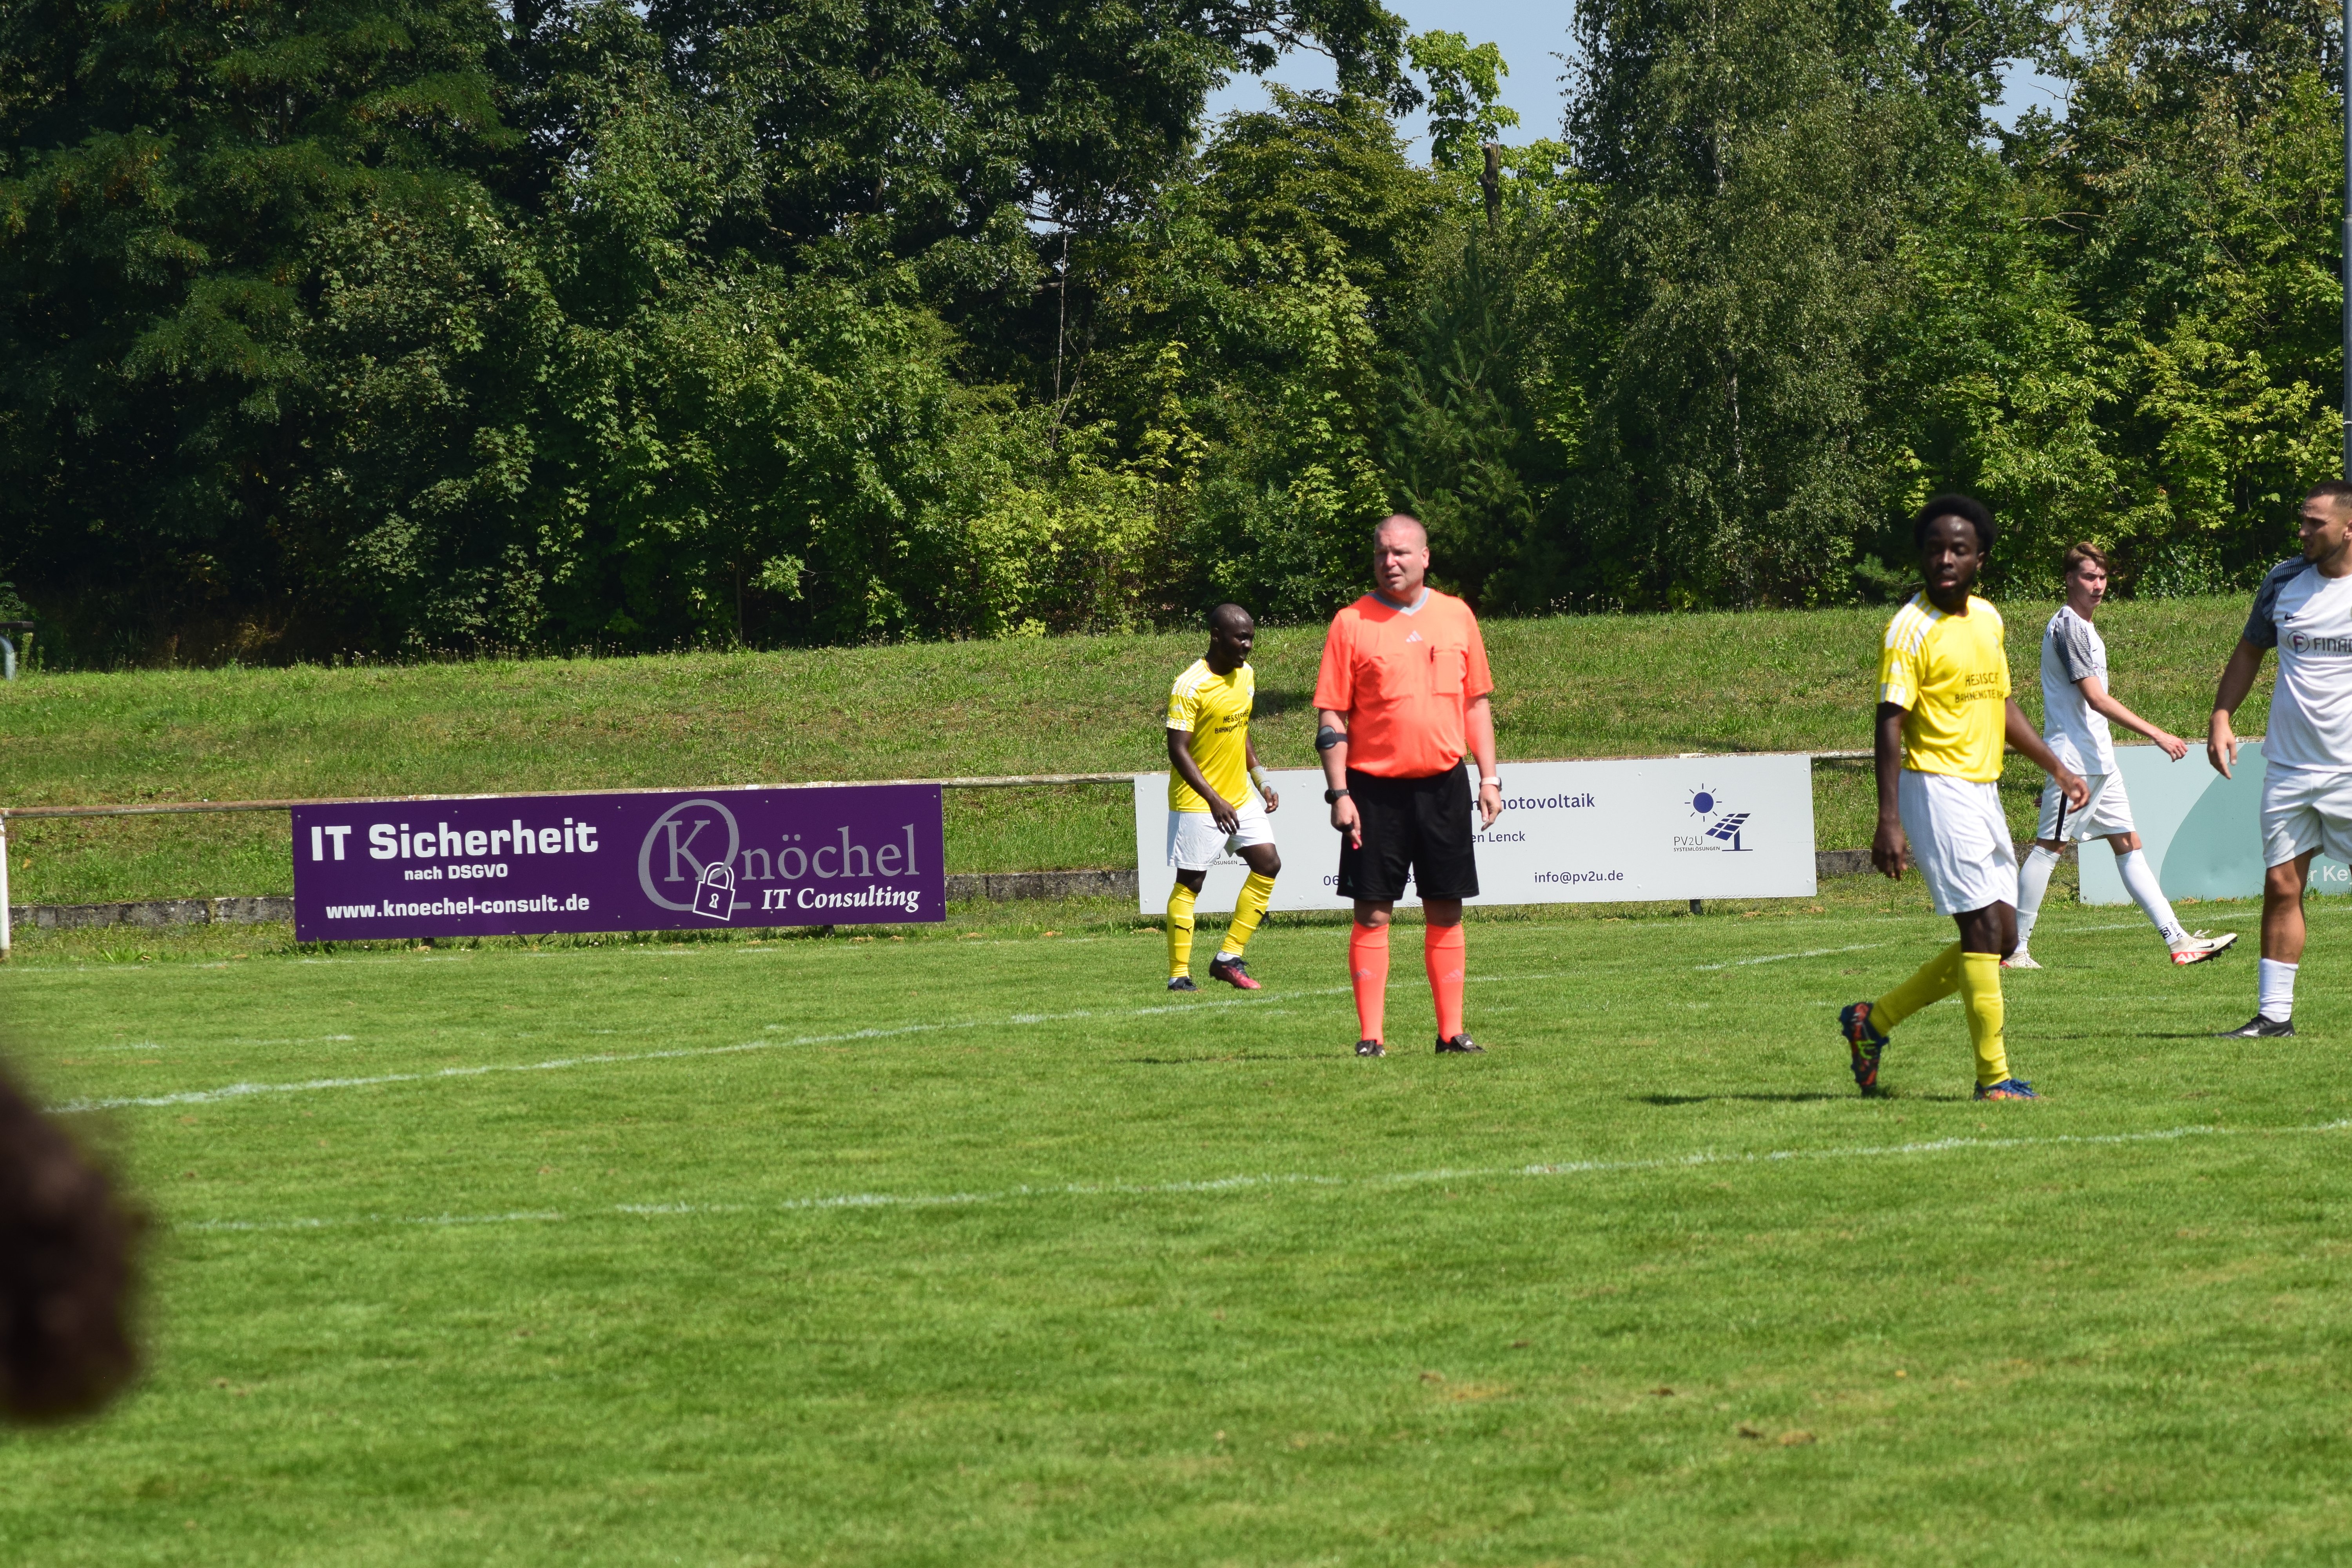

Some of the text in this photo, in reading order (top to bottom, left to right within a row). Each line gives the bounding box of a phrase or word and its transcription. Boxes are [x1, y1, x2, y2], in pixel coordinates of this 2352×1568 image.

[1501, 793, 1595, 809] otovoltaik
[311, 817, 598, 861] IT Sicherheit
[1489, 831, 1526, 842] Lenck
[1674, 836, 1703, 846] PV2U
[663, 820, 920, 882] Knöchel
[404, 864, 508, 880] nach DSGVO
[1534, 870, 1623, 885] info@pv2u.de
[326, 893, 590, 918] www.knoechel-consult.de
[761, 885, 920, 913] IT Consulting
